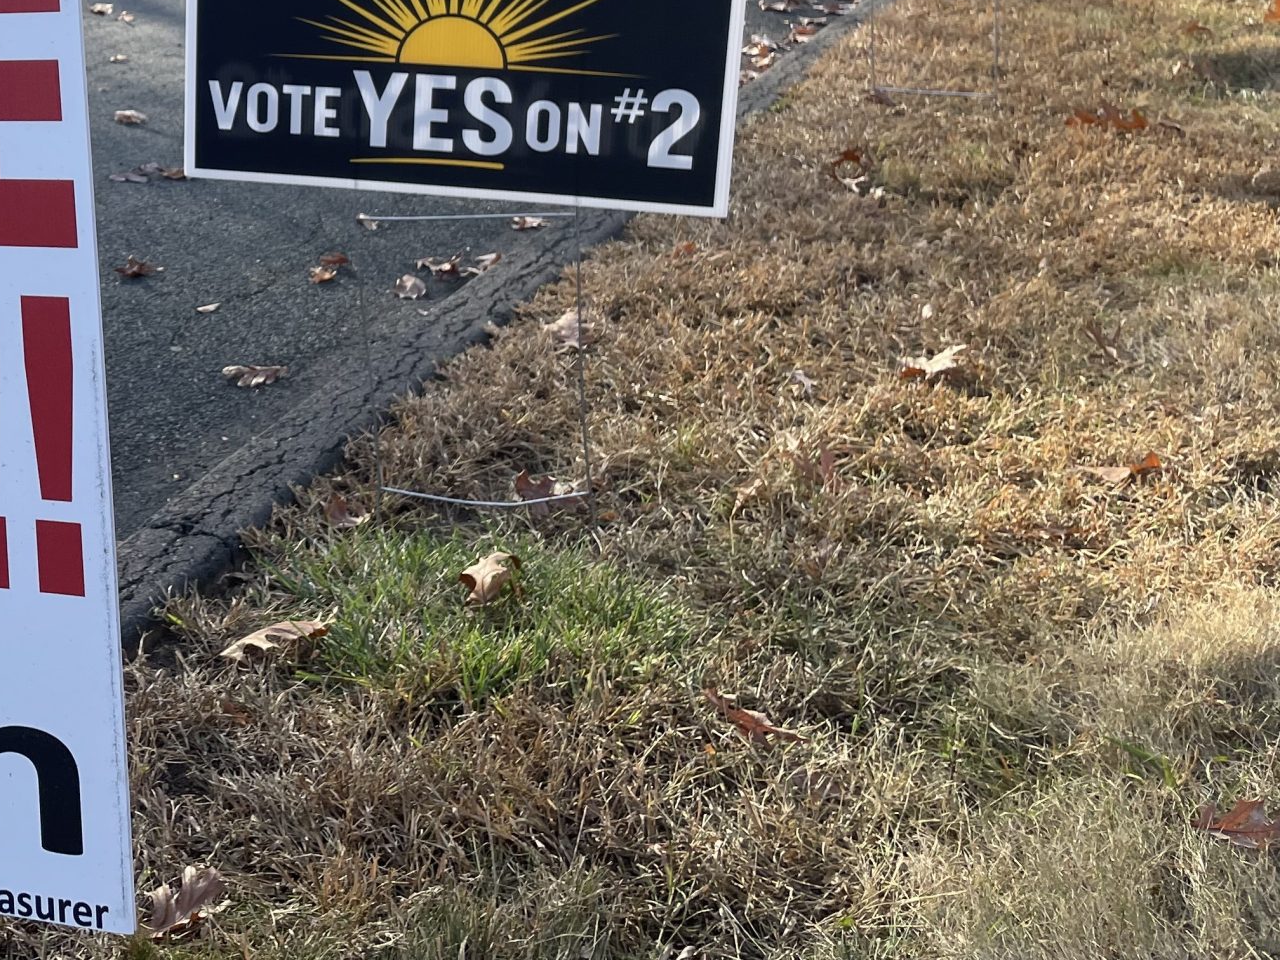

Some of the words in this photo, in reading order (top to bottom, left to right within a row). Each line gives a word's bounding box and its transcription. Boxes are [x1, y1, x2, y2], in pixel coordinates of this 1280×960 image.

[209, 79, 341, 137] VOTE
[353, 69, 513, 156] YES
[525, 99, 603, 156] ON
[610, 87, 701, 170] #2
